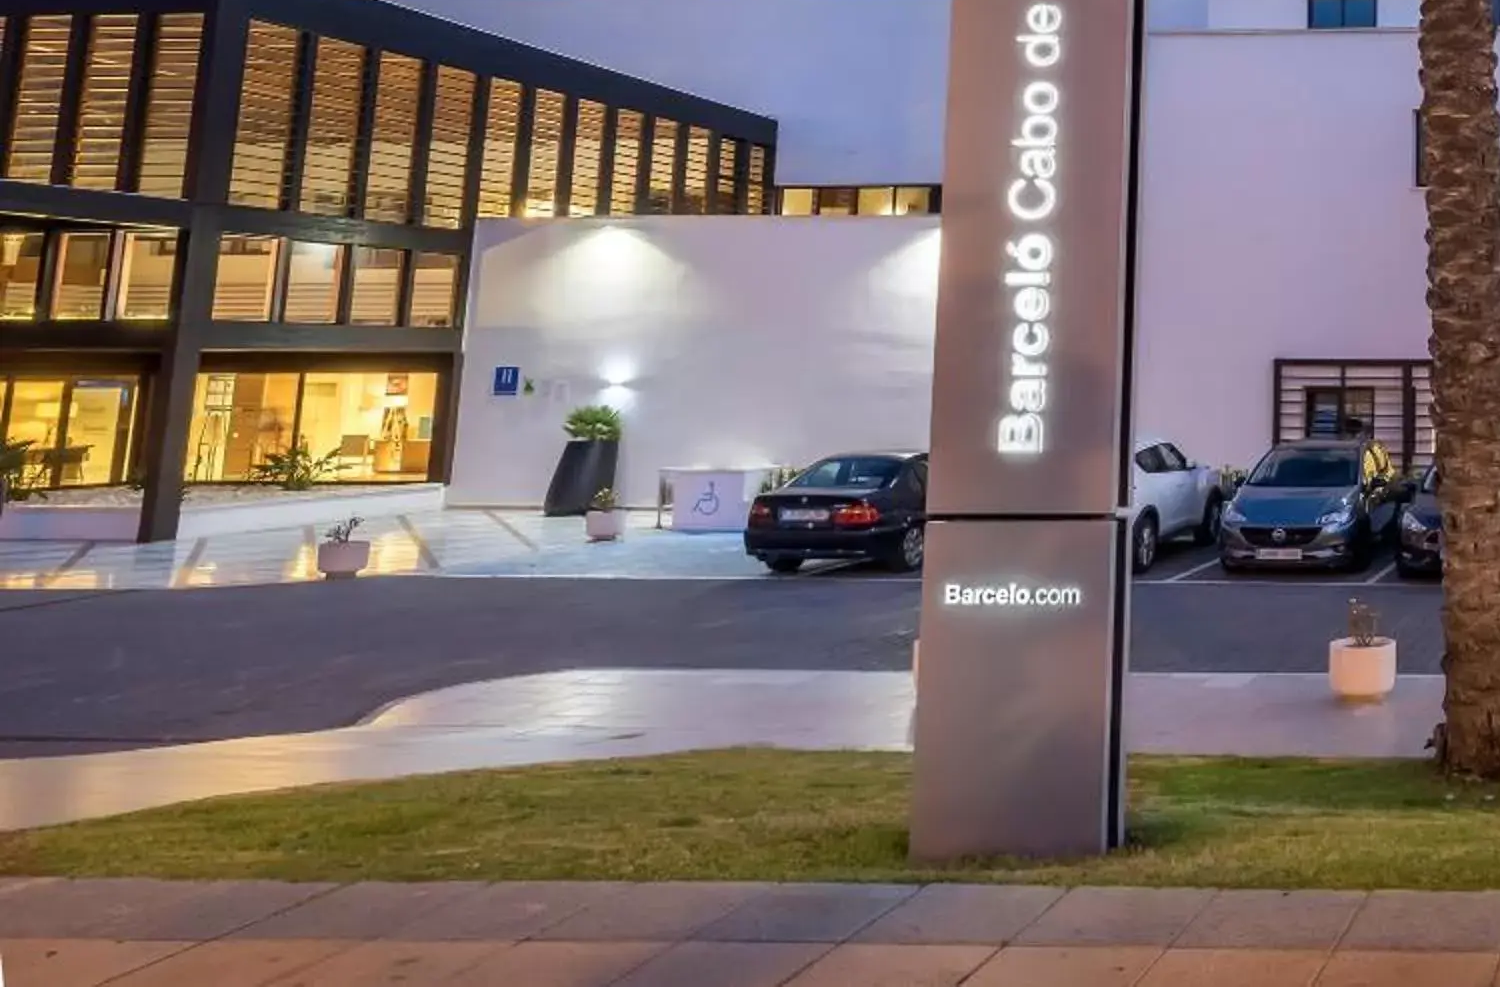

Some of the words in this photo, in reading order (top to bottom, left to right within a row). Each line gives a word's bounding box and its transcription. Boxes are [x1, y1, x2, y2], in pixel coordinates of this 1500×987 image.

[1016, 3, 1062, 67] de
[1008, 81, 1059, 220] Cabo
[998, 233, 1053, 453] Barceló
[944, 582, 1081, 605] Barcelo.com
